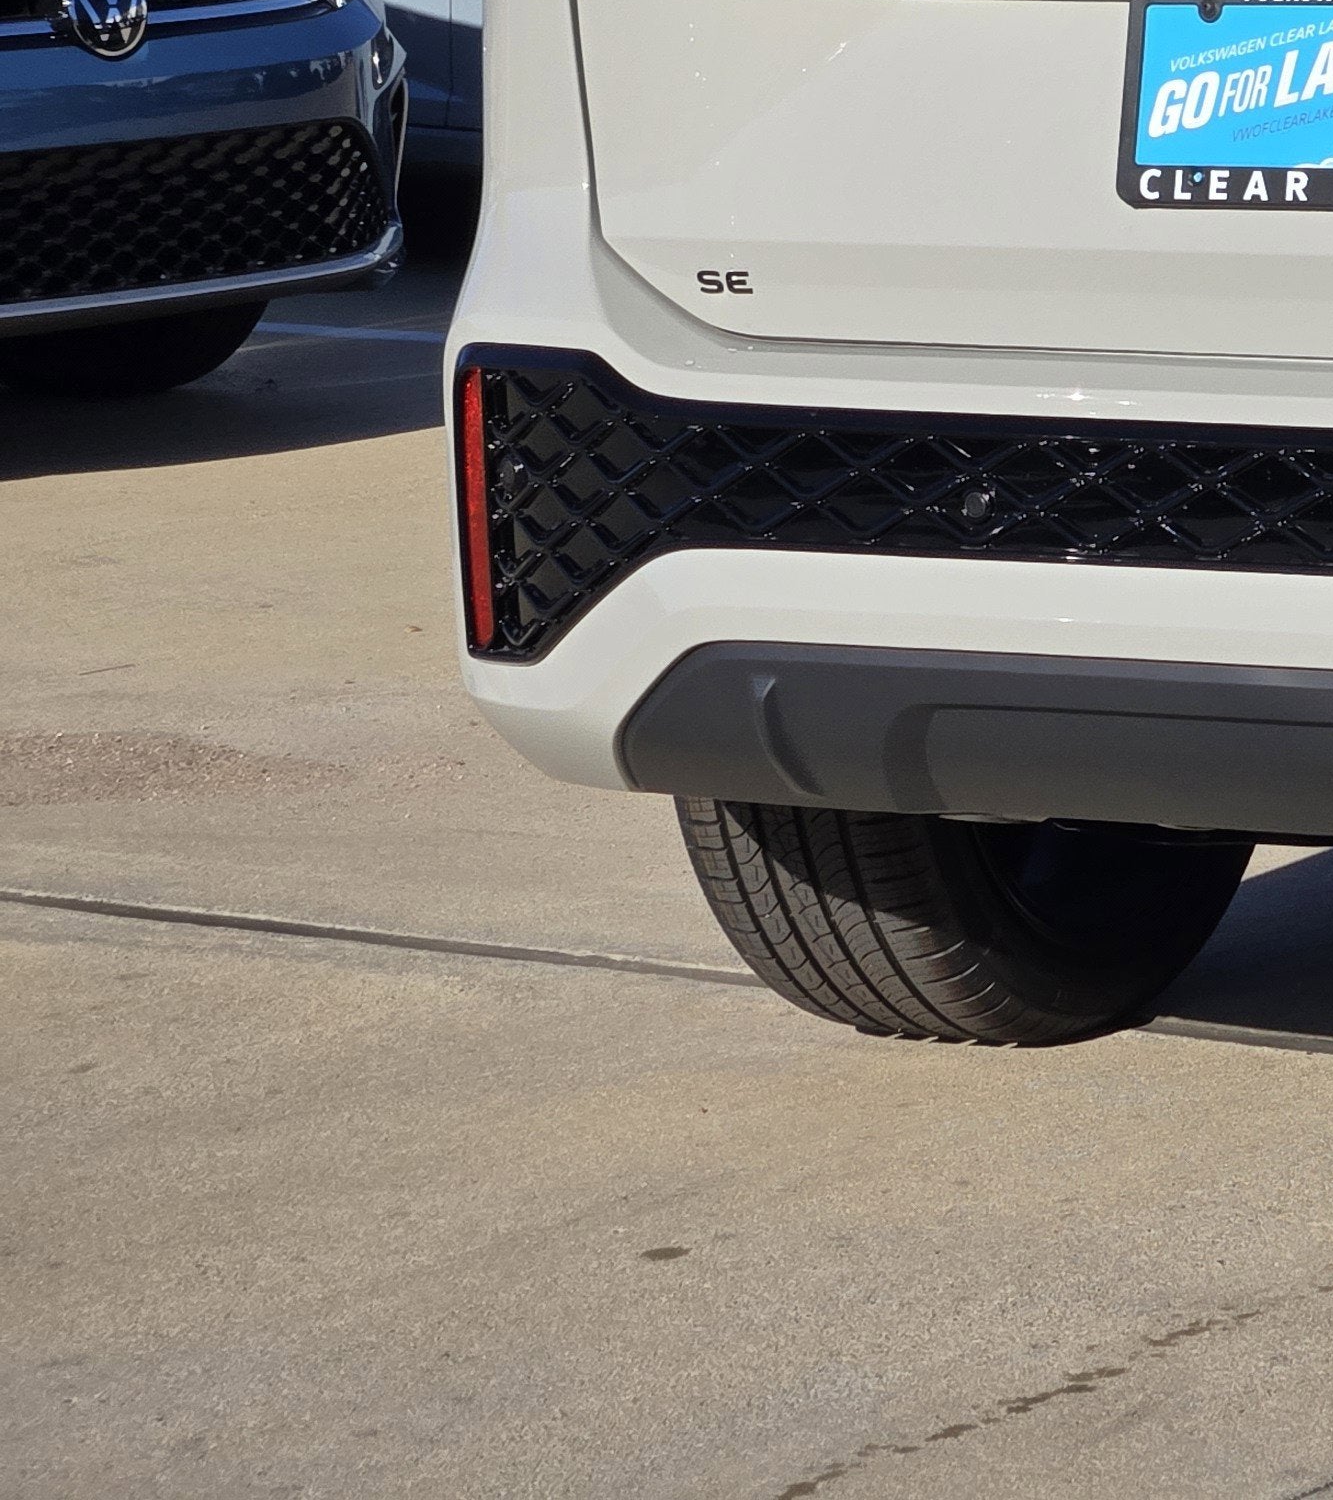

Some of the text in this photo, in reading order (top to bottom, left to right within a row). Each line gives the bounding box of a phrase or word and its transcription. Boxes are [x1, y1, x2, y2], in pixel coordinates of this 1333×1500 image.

[1170, 37, 1267, 72] VOLKSWAGEN
[1269, 23, 1315, 48] CLEAR
[1148, 71, 1220, 138] GO
[1218, 65, 1273, 117] FOR
[1139, 168, 1309, 202] CLEAR
[696, 270, 754, 295] SE
